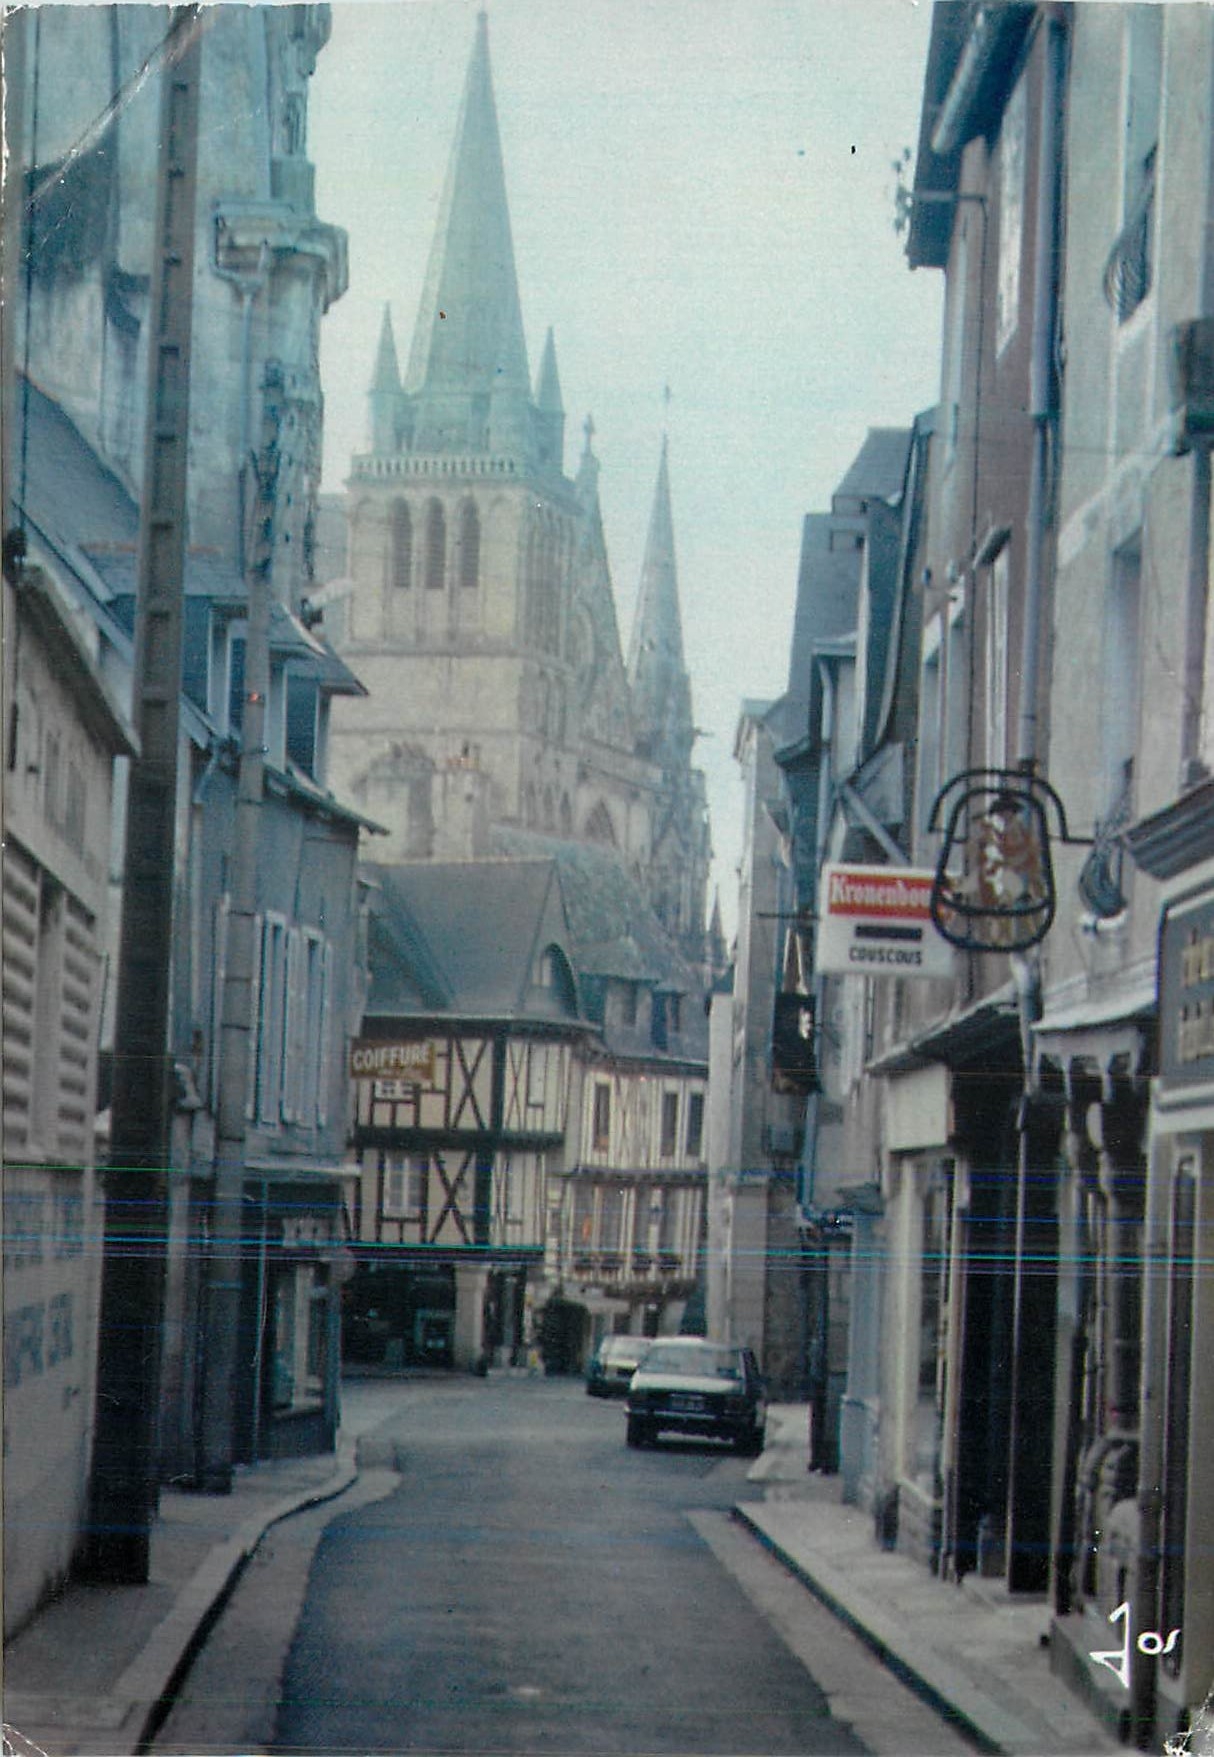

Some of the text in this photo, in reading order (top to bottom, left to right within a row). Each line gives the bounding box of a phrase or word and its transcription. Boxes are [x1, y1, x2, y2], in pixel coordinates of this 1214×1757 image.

[831, 874, 948, 908] Kronenbou
[849, 946, 923, 967] COUSCOUS
[352, 1041, 430, 1072] COIFFURE
